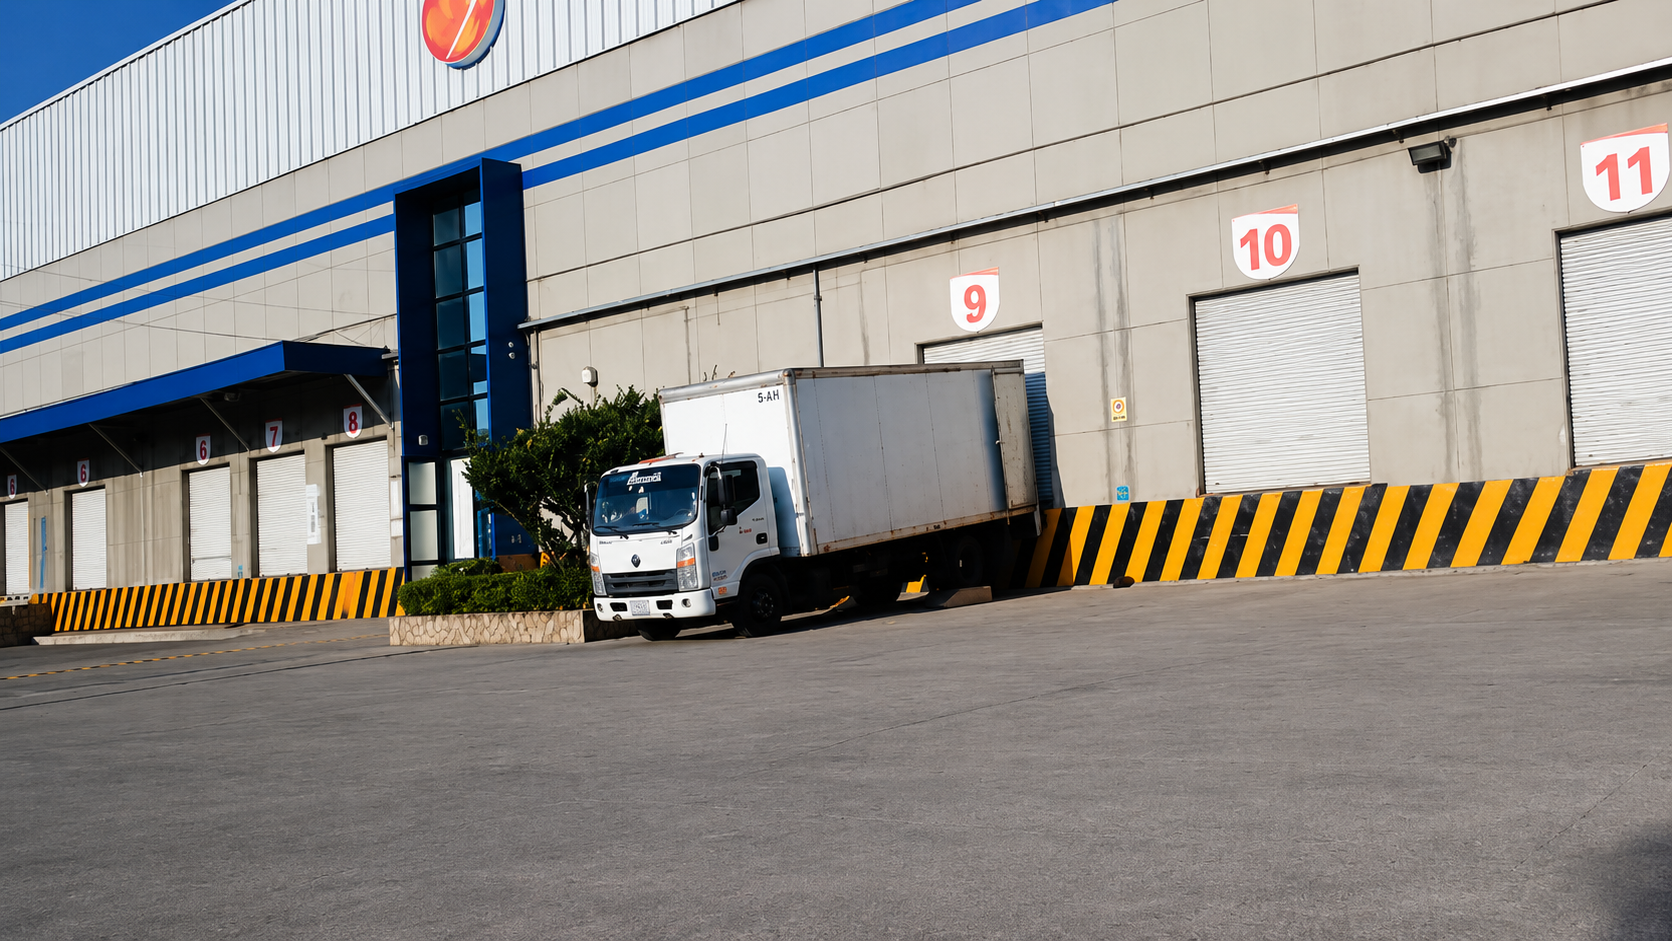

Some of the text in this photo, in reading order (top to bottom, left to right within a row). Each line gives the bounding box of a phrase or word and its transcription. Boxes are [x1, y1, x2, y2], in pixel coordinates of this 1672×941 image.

[1595, 146, 1653, 202] 11
[1239, 223, 1292, 271] 10
[963, 284, 987, 324] 9
[348, 411, 358, 434] 8
[269, 425, 279, 447] 7
[200, 439, 207, 460] 6
[80, 463, 87, 483] 6
